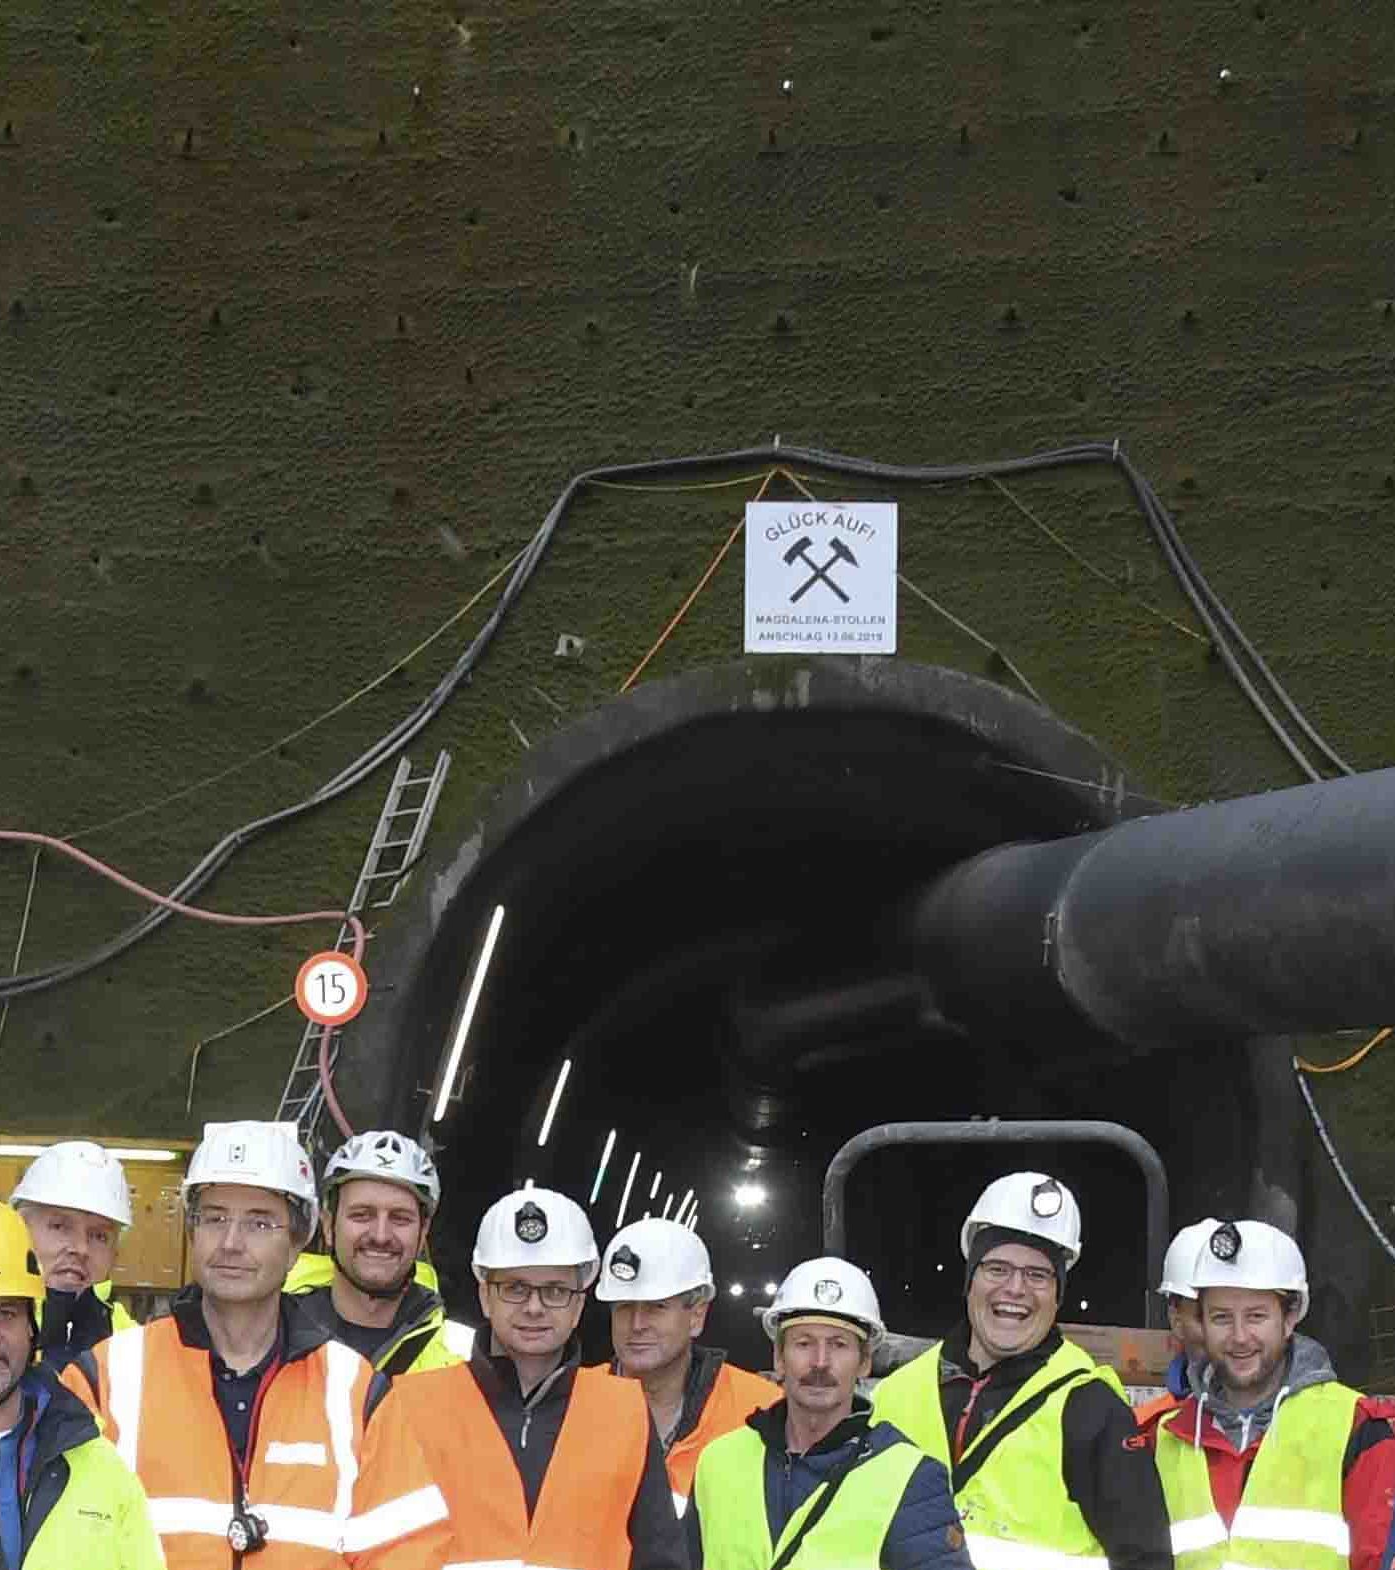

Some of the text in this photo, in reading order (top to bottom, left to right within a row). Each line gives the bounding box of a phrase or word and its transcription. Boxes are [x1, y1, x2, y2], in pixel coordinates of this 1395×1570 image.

[765, 511, 876, 542] GLÜCK AUF!
[758, 631, 822, 641] ANSCHLAG
[315, 973, 346, 1005] 15
